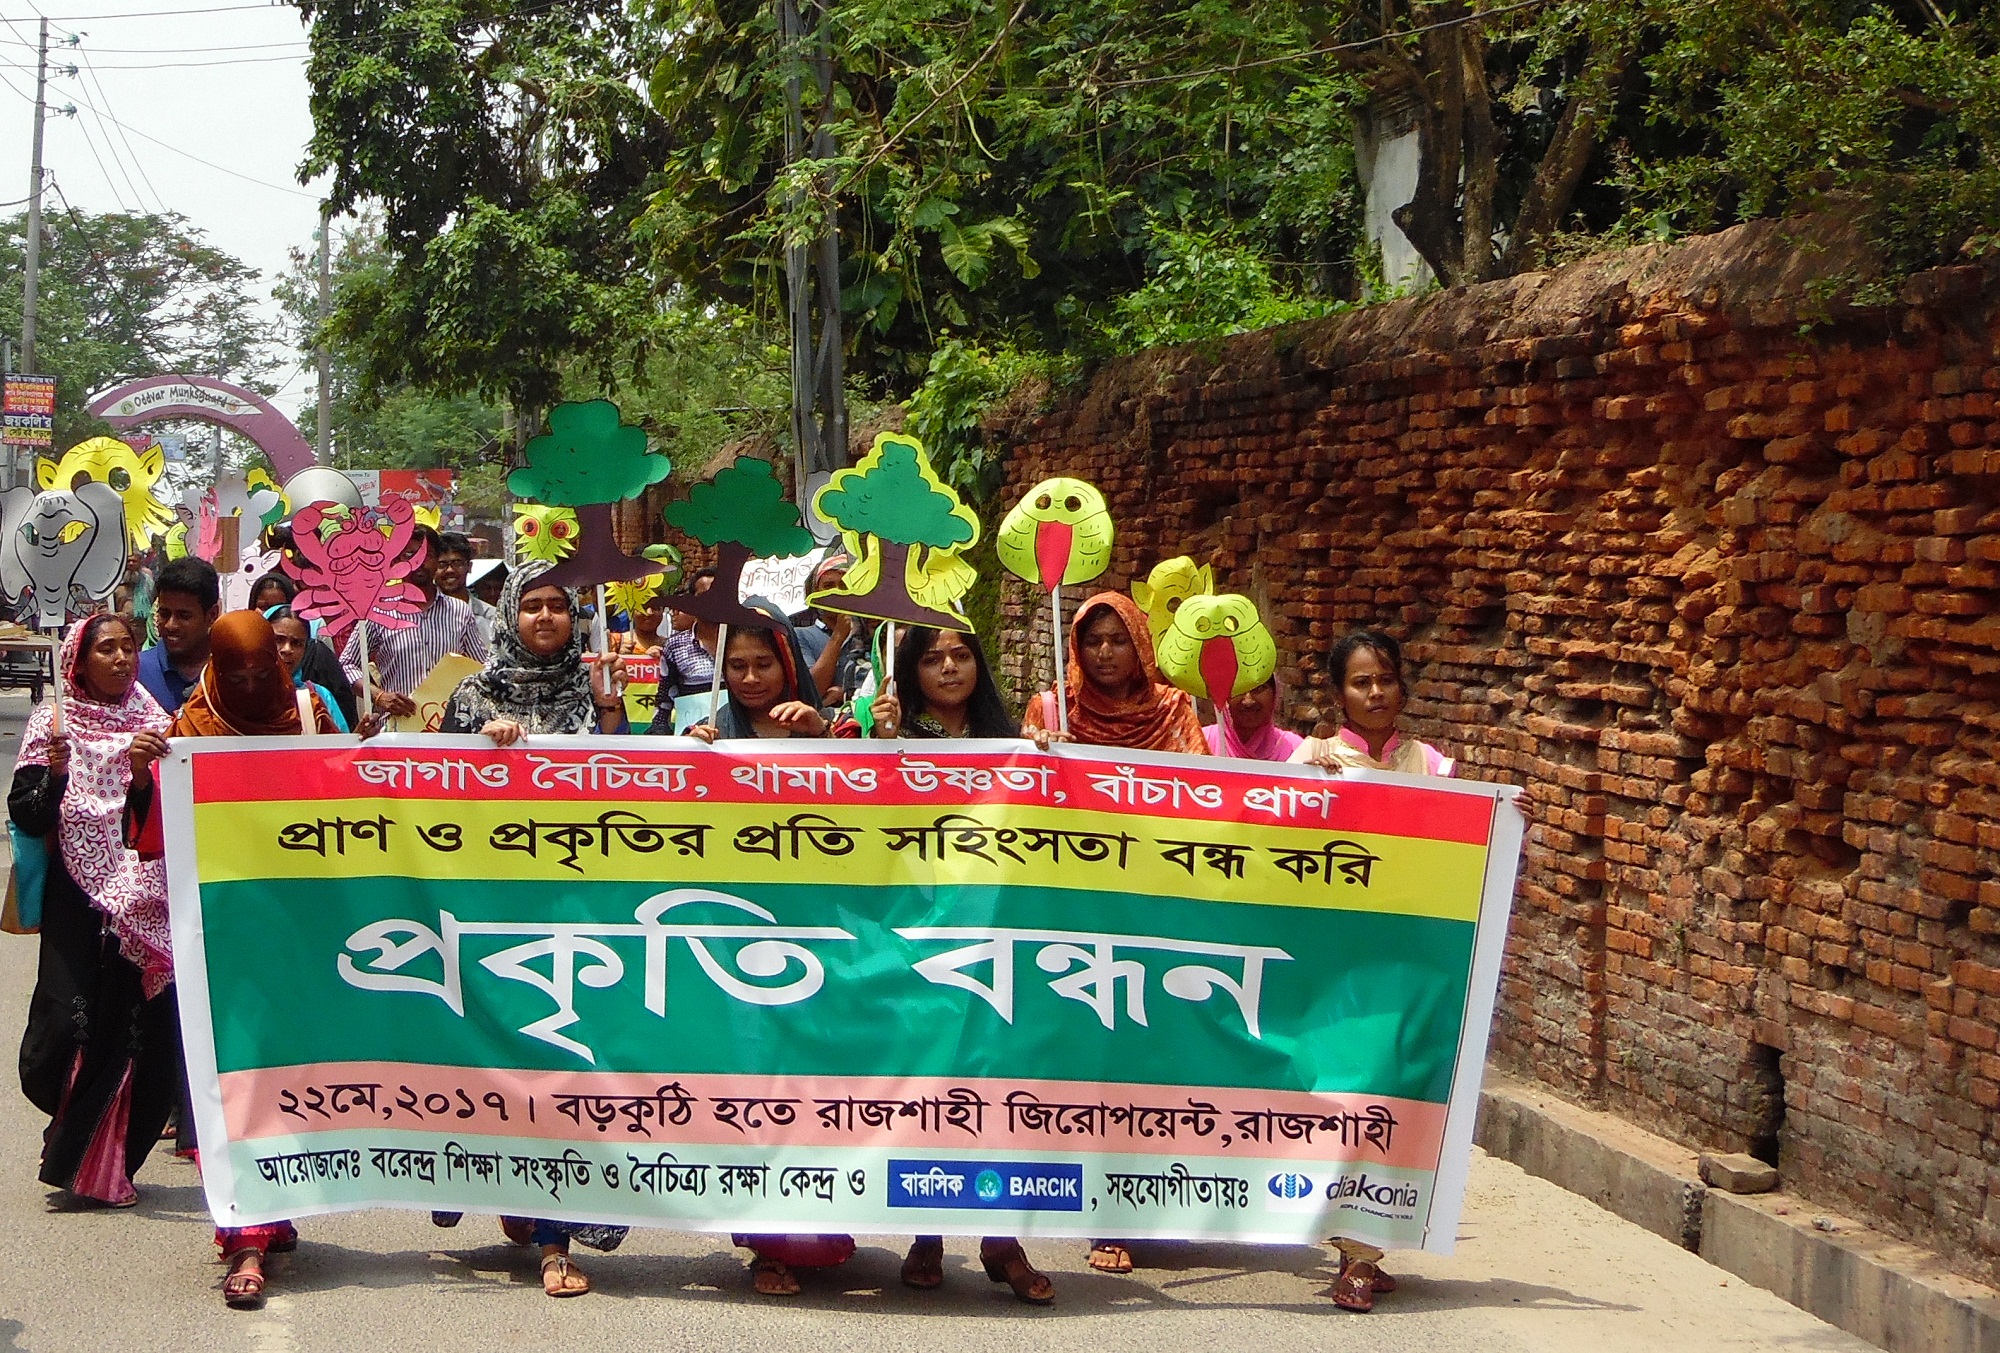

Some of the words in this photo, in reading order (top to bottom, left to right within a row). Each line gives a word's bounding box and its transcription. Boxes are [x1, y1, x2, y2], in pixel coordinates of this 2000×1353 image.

[134, 389, 165, 407] Oddvar
[169, 386, 228, 408] Munksgaard
[351, 758, 508, 790] জাগাও
[526, 753, 707, 797] বৈচিত্র্য,
[731, 762, 877, 794] থামাও
[896, 758, 1066, 803] উষ্ণতা,
[1086, 766, 1222, 808] বাঁচাও
[1243, 786, 1338, 818] প্রাণ
[278, 814, 396, 857] প্রাণ
[416, 824, 462, 852] ও
[490, 811, 715, 874] প্রকৃতির
[734, 814, 865, 861] প্রতি
[878, 815, 1140, 870] সহিংসতা
[1154, 839, 1254, 879] বন্ধ
[1267, 840, 1382, 887] করি
[338, 889, 857, 1065] প্রকৃতি
[891, 927, 1294, 1039] বন্ধন
[551, 1082, 699, 1138] বড়কুঠি
[708, 1098, 803, 1134] হতে
[813, 1088, 991, 1138] রাজশাহী
[368, 1148, 437, 1185] বরেন্দ্র
[443, 1141, 503, 1185] শিক্ষা
[508, 1149, 593, 1202] সংস্কৃতি
[601, 1164, 619, 1188] ও
[627, 1152, 711, 1196] বৈচিত্র্য
[716, 1162, 771, 1197] রক্ষা
[780, 1167, 838, 1203] কেন্দ্র
[847, 1170, 865, 1195] ও
[900, 1167, 964, 1196] বারসিক
[1010, 1177, 1077, 1197] BARCIK
[1326, 1174, 1418, 1207] diakonia
